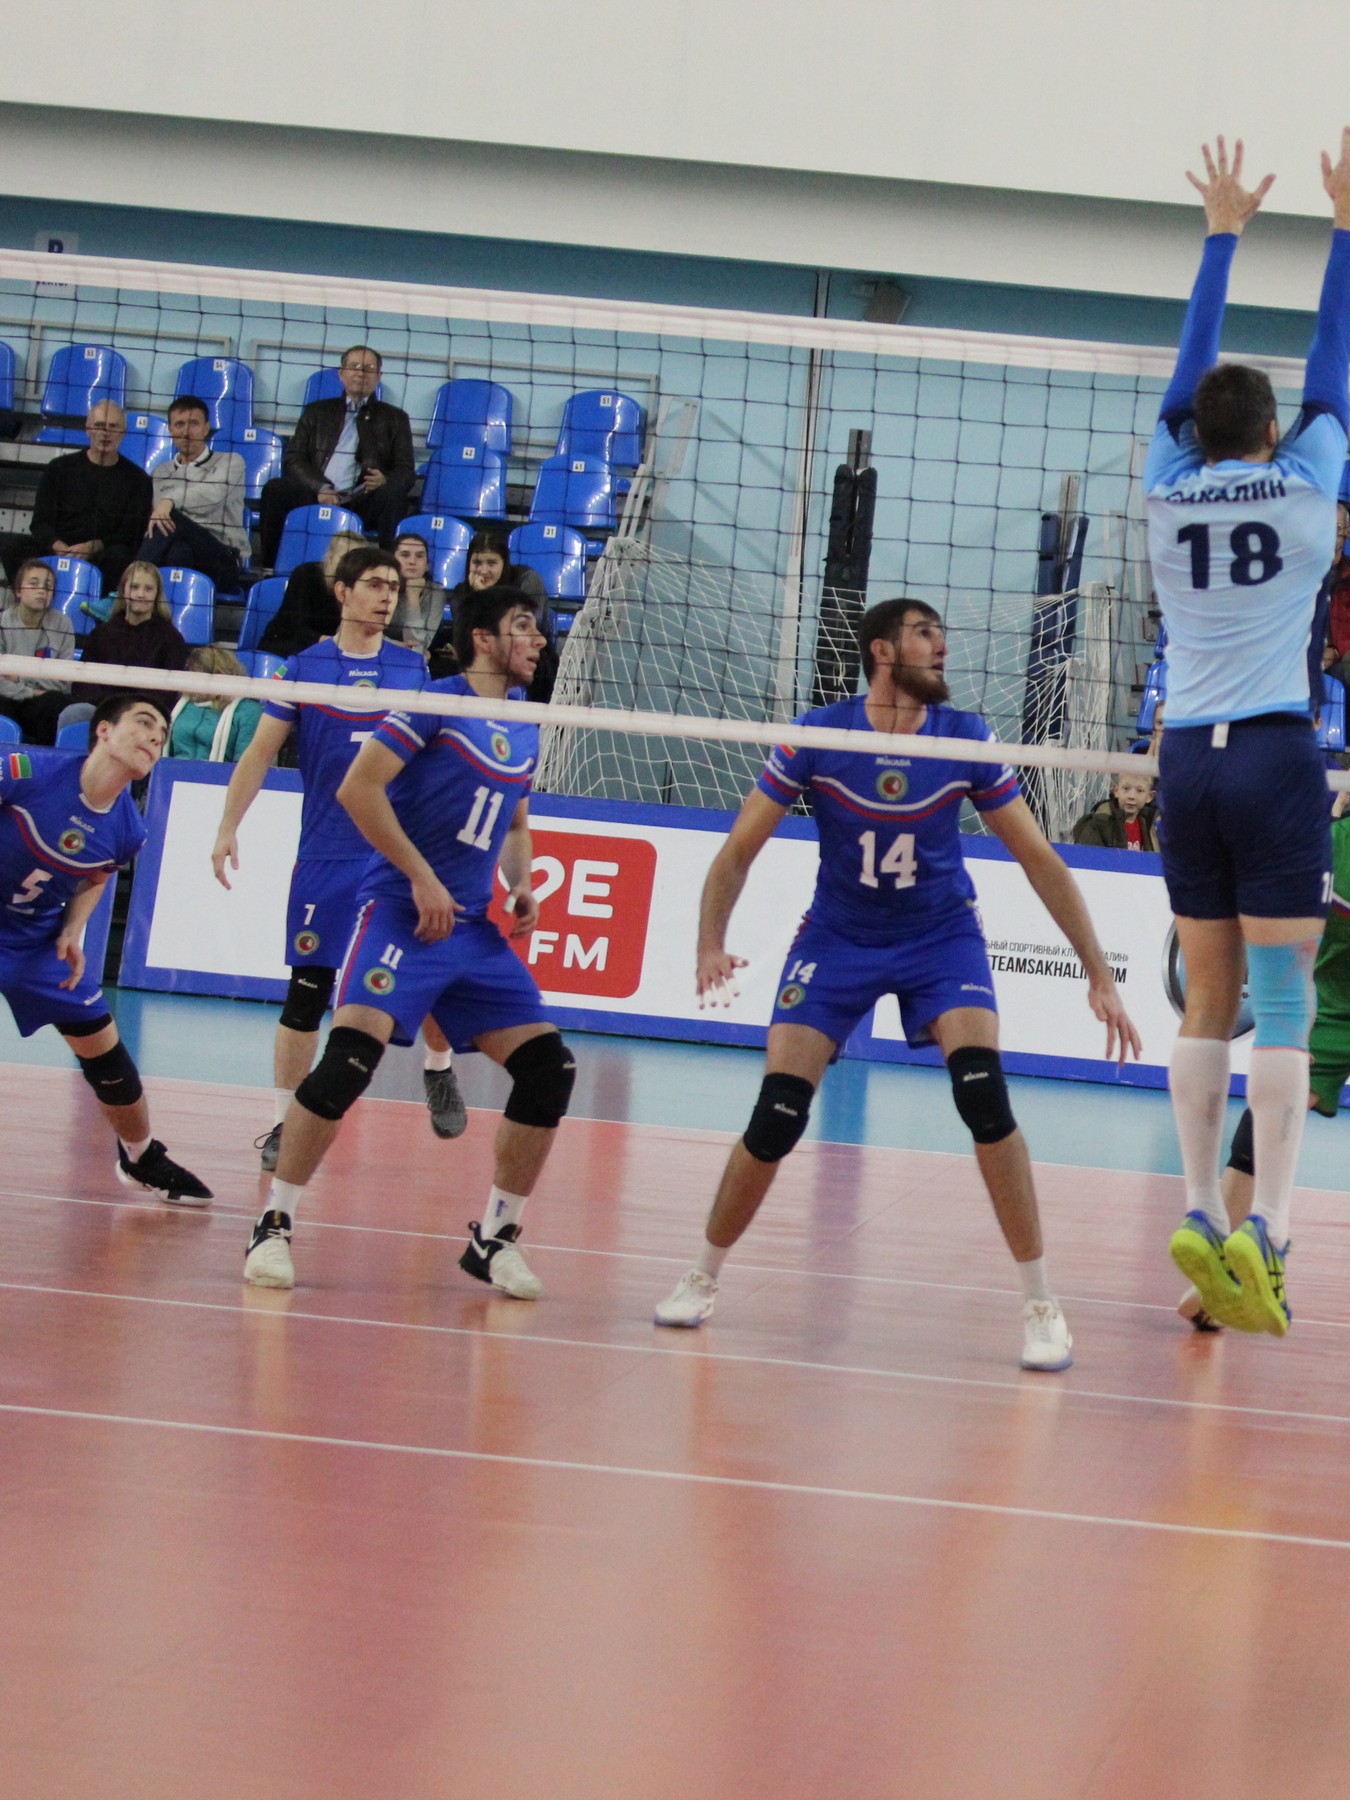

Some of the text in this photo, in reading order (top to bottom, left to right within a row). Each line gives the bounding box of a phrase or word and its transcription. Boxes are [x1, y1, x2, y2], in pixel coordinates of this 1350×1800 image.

[1177, 521, 1283, 589] 18
[456, 786, 505, 851] 11
[859, 830, 918, 890] 14
[12, 868, 53, 904] 5
[1321, 871, 1334, 904] 1
[304, 904, 315, 926] 7
[381, 944, 403, 970] 11
[528, 930, 609, 971] FM
[1009, 942, 1060, 956] СПОРТИВНЫЙ
[787, 959, 817, 985] 14
